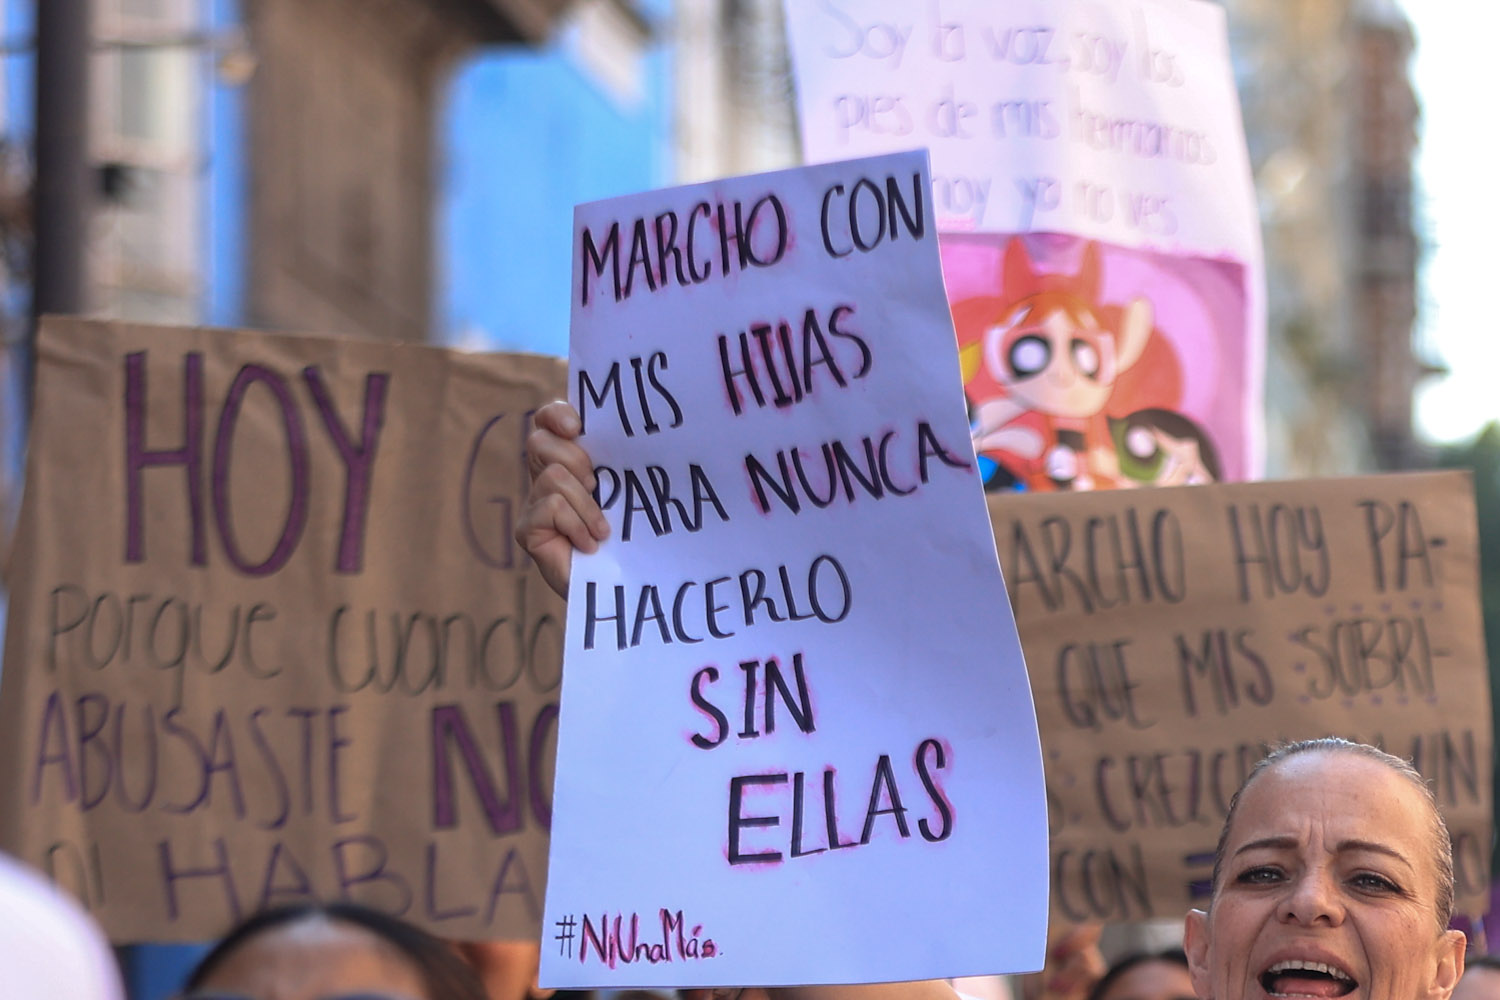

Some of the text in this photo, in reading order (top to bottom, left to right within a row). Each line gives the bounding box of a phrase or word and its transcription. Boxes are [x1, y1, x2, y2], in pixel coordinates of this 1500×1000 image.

[834, 92, 914, 145] pies
[925, 80, 978, 139] de
[989, 99, 1060, 140] mis
[580, 172, 925, 307] MARCHO CON
[577, 305, 873, 438] MIS HIJAS
[125, 349, 393, 578] HOY
[592, 462, 731, 542] PARA
[743, 421, 972, 515] NUNCA
[584, 554, 852, 652] HACERLO
[1008, 506, 1188, 616] ARCHO
[1227, 500, 1332, 602] HOY
[327, 577, 563, 698] cuando
[1055, 638, 1158, 731] QUE
[1174, 627, 1276, 718] MIS
[31, 689, 359, 831] ABUSASTE
[690, 652, 817, 750] SIN
[728, 738, 954, 867] ELLAS
[1054, 838, 1156, 924] CON
